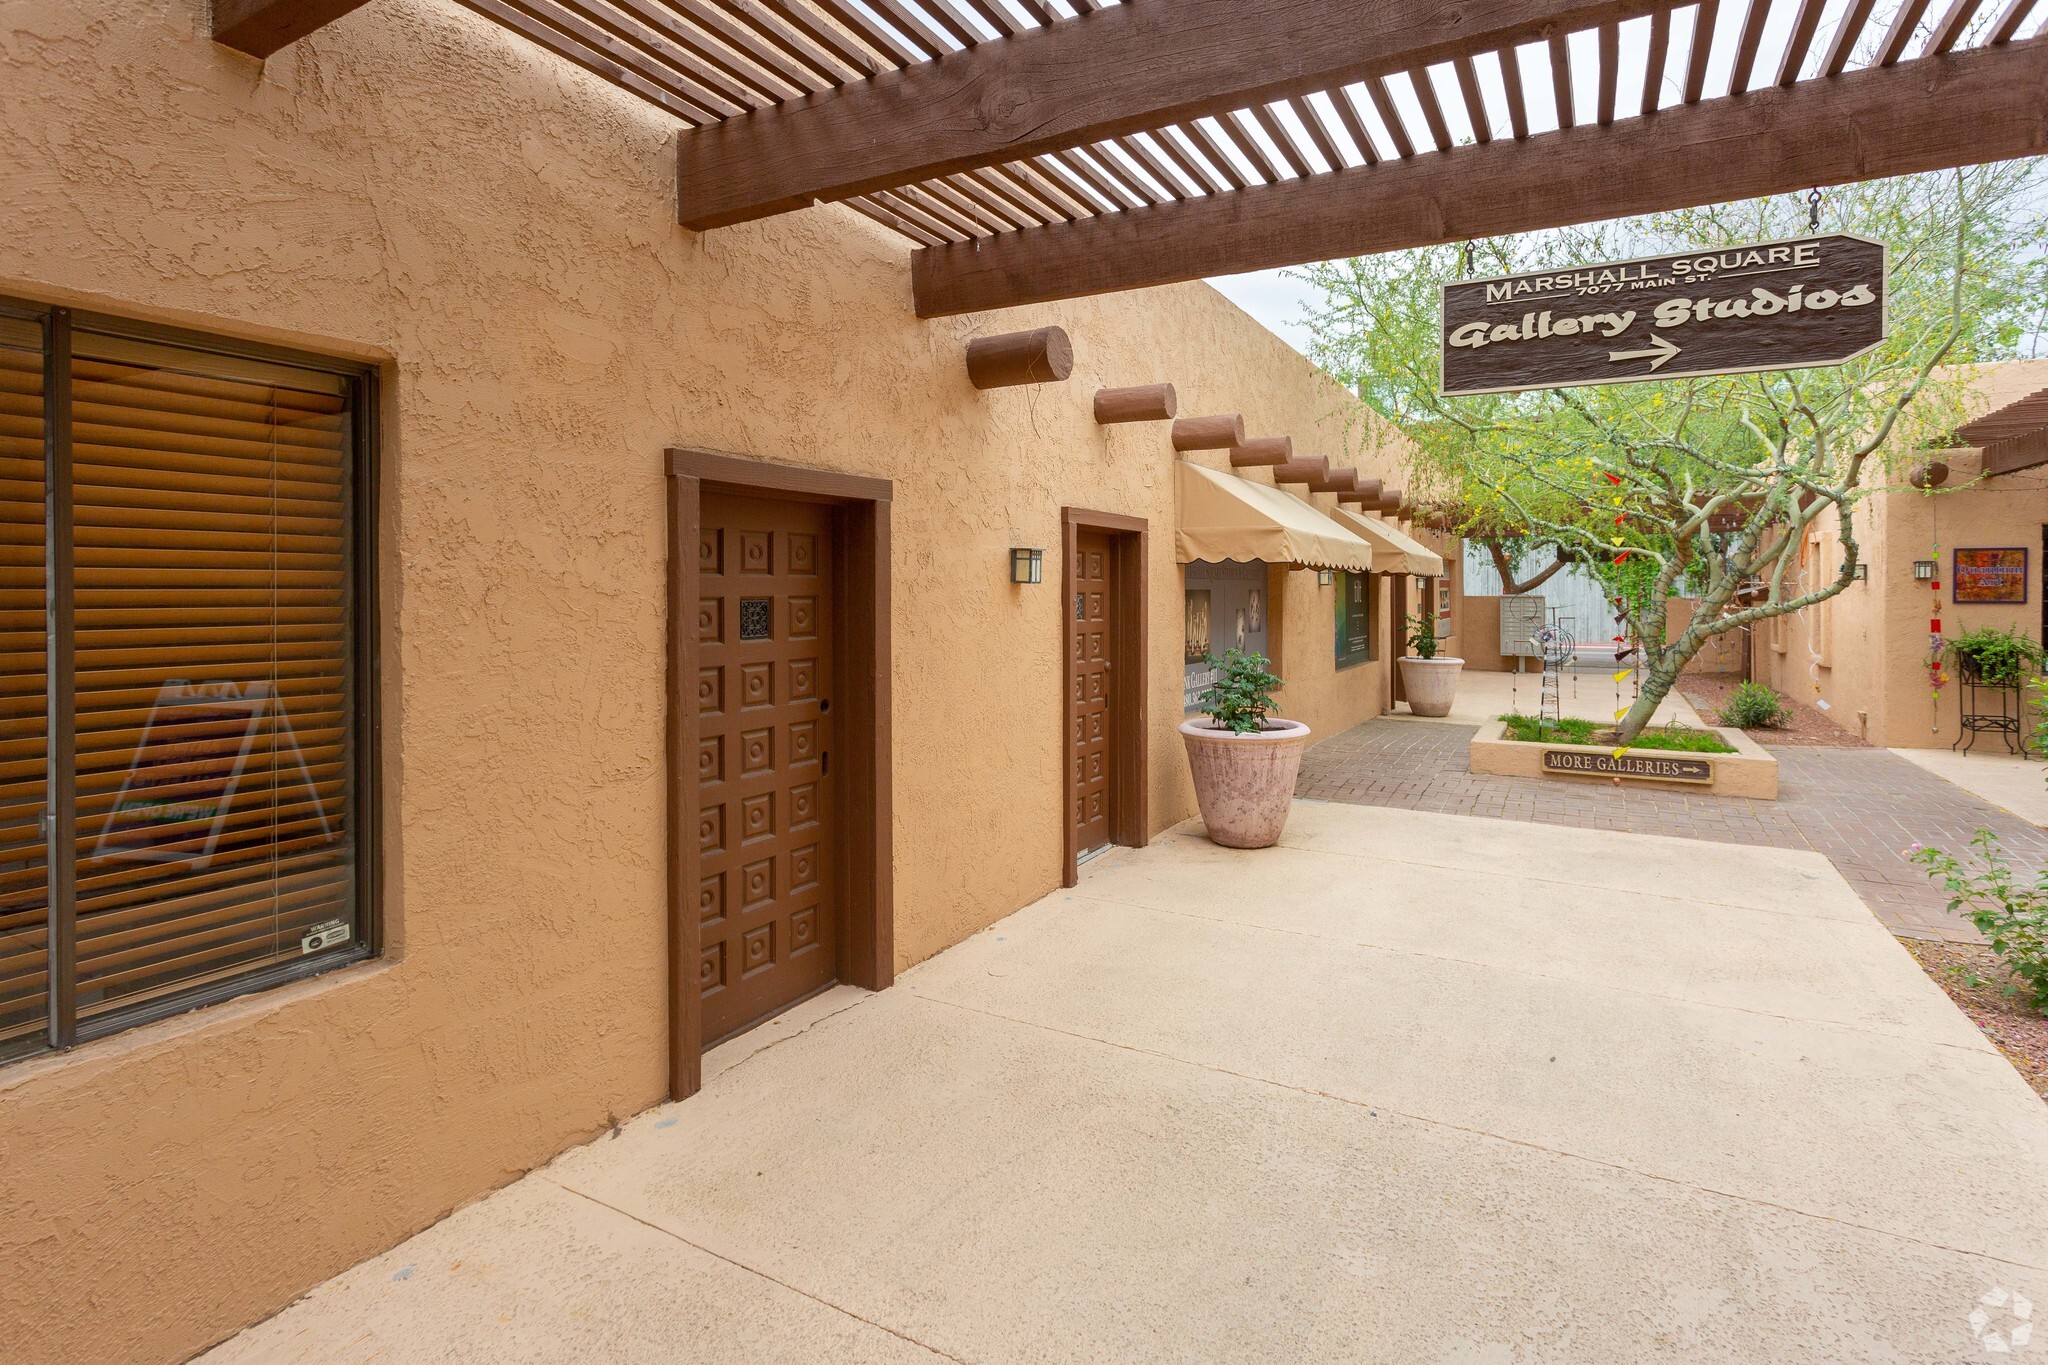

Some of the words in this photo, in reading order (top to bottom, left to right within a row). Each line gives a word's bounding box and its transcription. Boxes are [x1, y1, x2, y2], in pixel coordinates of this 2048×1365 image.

[1486, 264, 1659, 303] MARSHALL
[1671, 242, 1820, 276] SQUARE
[1576, 282, 1625, 297] 7077
[1631, 277, 1676, 290] MAIN
[1684, 273, 1712, 284] ST.
[1449, 310, 1637, 349] Gallery
[1653, 284, 1876, 328] Studios
[1957, 564, 2024, 577] Quantum
[1977, 577, 2003, 587] Art
[1550, 754, 1592, 769] MORE
[1597, 757, 1680, 776] GALLERIES
[310, 918, 340, 932] WARNING
